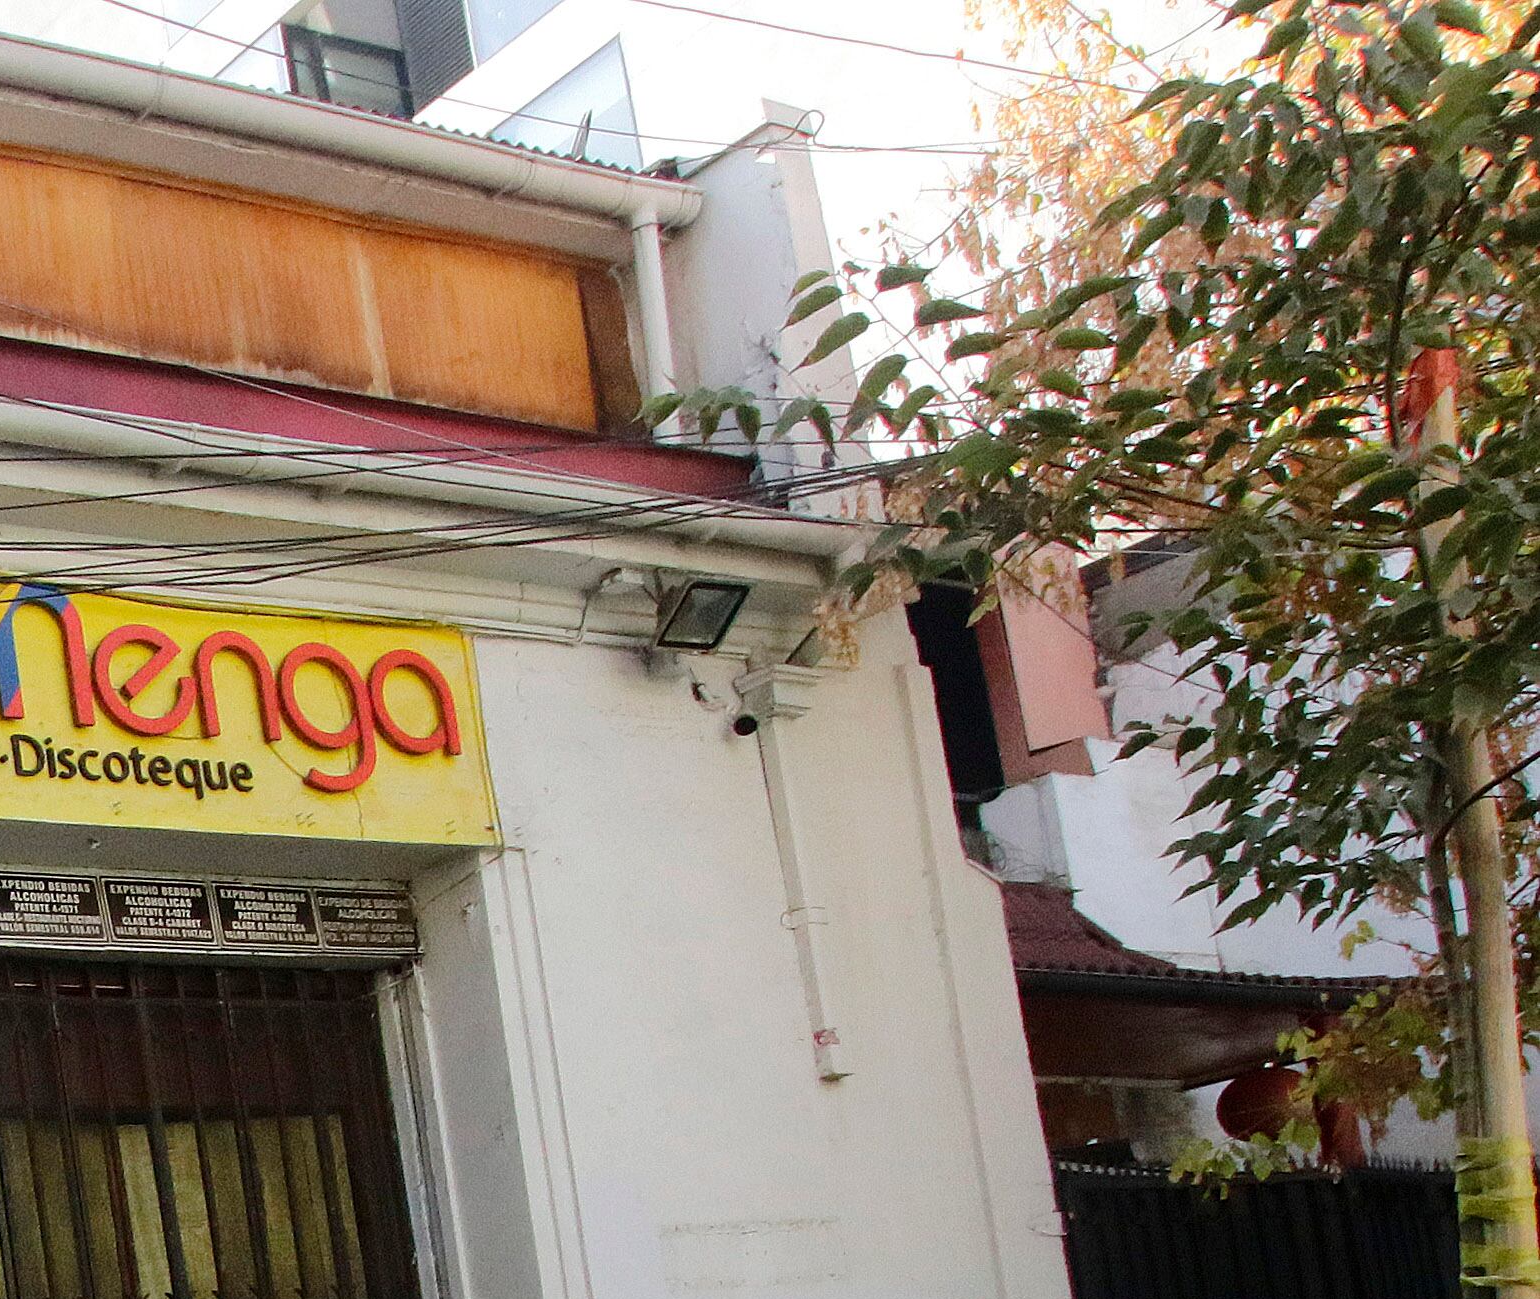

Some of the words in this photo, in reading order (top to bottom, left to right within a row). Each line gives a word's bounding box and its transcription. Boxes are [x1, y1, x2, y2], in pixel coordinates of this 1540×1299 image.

[48, 881, 91, 893] BEBIDAS
[109, 884, 159, 896] EXPENDIO
[161, 886, 203, 898] BEBIDAS
[9, 891, 80, 904] ALCOHOLICAS
[220, 889, 266, 900] EXPENDIO
[14, 903, 50, 913] PATENTE
[124, 895, 193, 908] ALCOHOLICAS
[233, 900, 298, 913] ALCOHOLICAS
